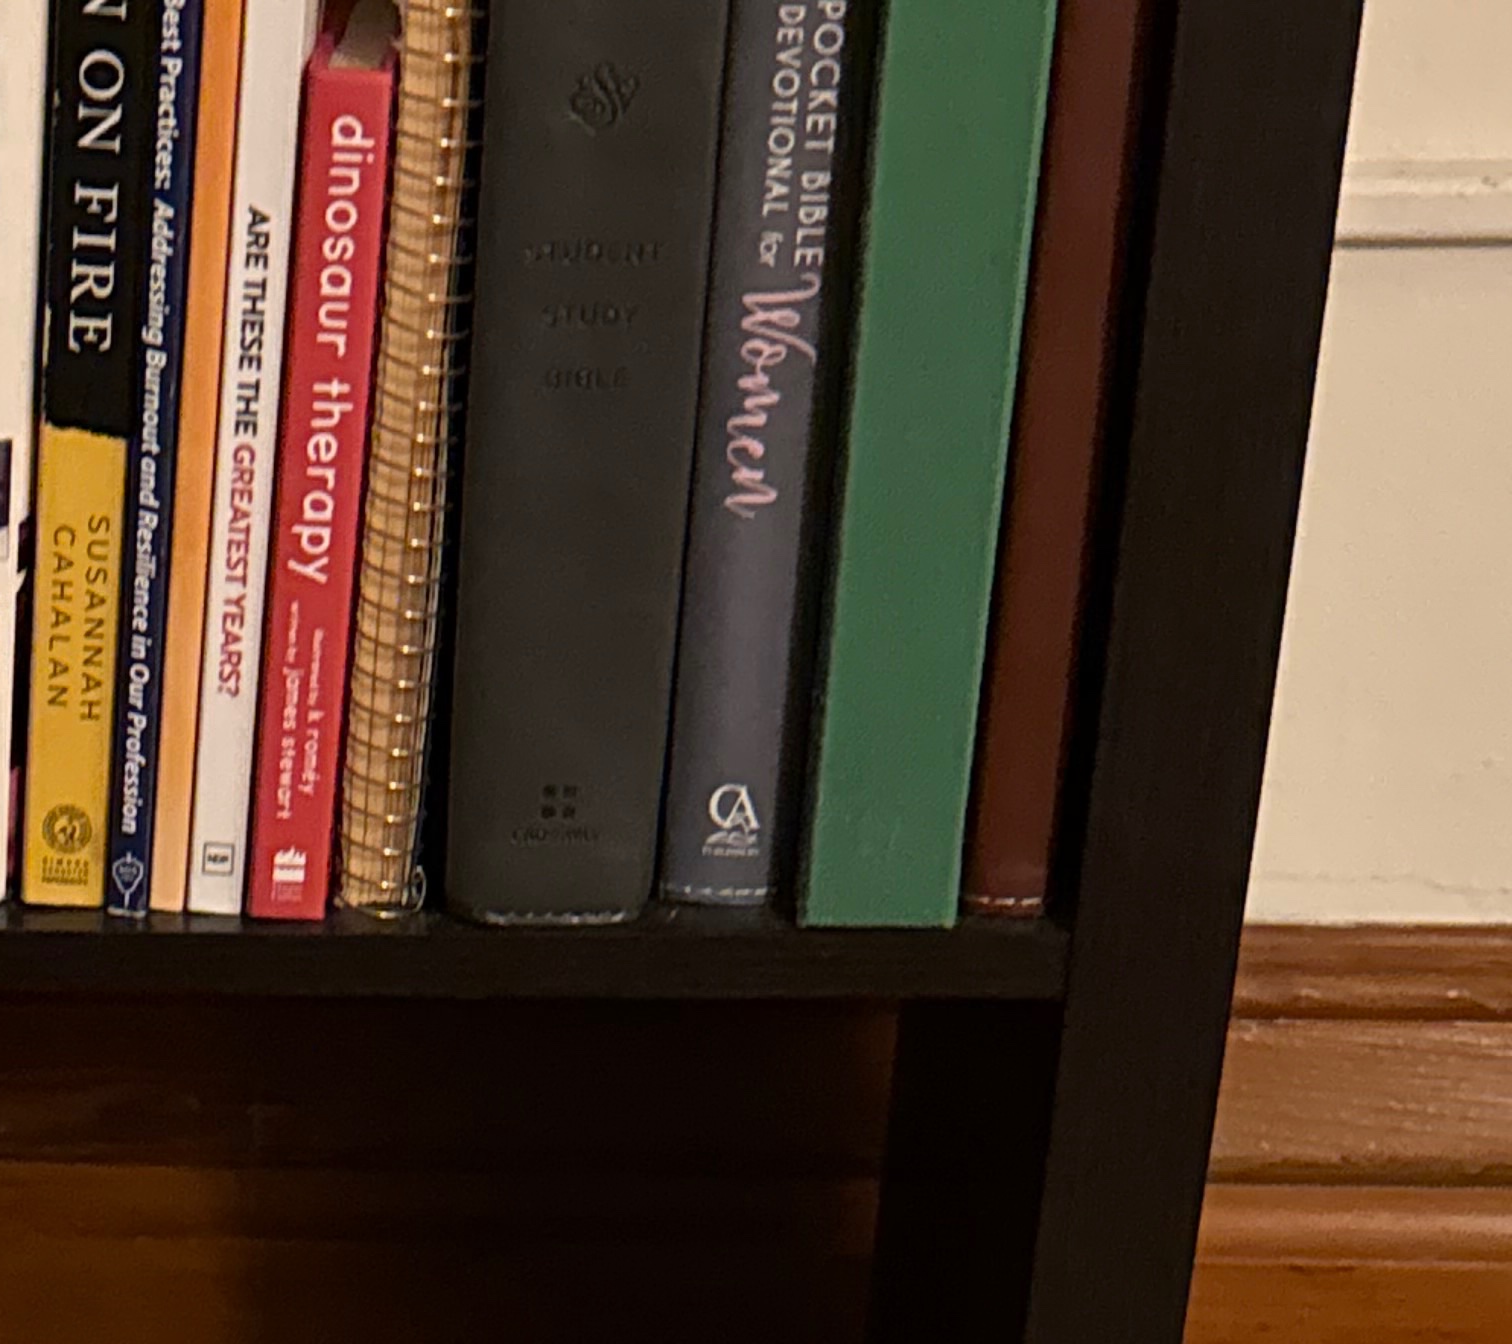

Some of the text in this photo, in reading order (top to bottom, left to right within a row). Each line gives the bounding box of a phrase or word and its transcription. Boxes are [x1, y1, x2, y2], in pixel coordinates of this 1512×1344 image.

[75, 48, 126, 155] ON
[761, 4, 807, 218] DEVOTIONAL
[793, 0, 846, 269] POCKET BIBLE
[67, 178, 120, 355] FIRE
[141, 198, 175, 347] Addressing
[541, 306, 637, 328] STUDY
[141, 348, 167, 455] Burnout
[287, 113, 376, 586] dinosaur therapy
[543, 365, 631, 391] BIBLE
[724, 271, 823, 520] Women
[139, 456, 160, 509] and
[217, 204, 270, 699] ARE THESE THE GREATEST YEARS?
[46, 523, 76, 709] CAHALAN
[79, 513, 111, 722] SUSANNAH
[133, 509, 159, 633] Resilience
[128, 662, 150, 708] Our
[130, 633, 153, 660] in
[282, 665, 305, 731] james
[121, 708, 147, 840] Profession
[275, 735, 296, 820] stewart
